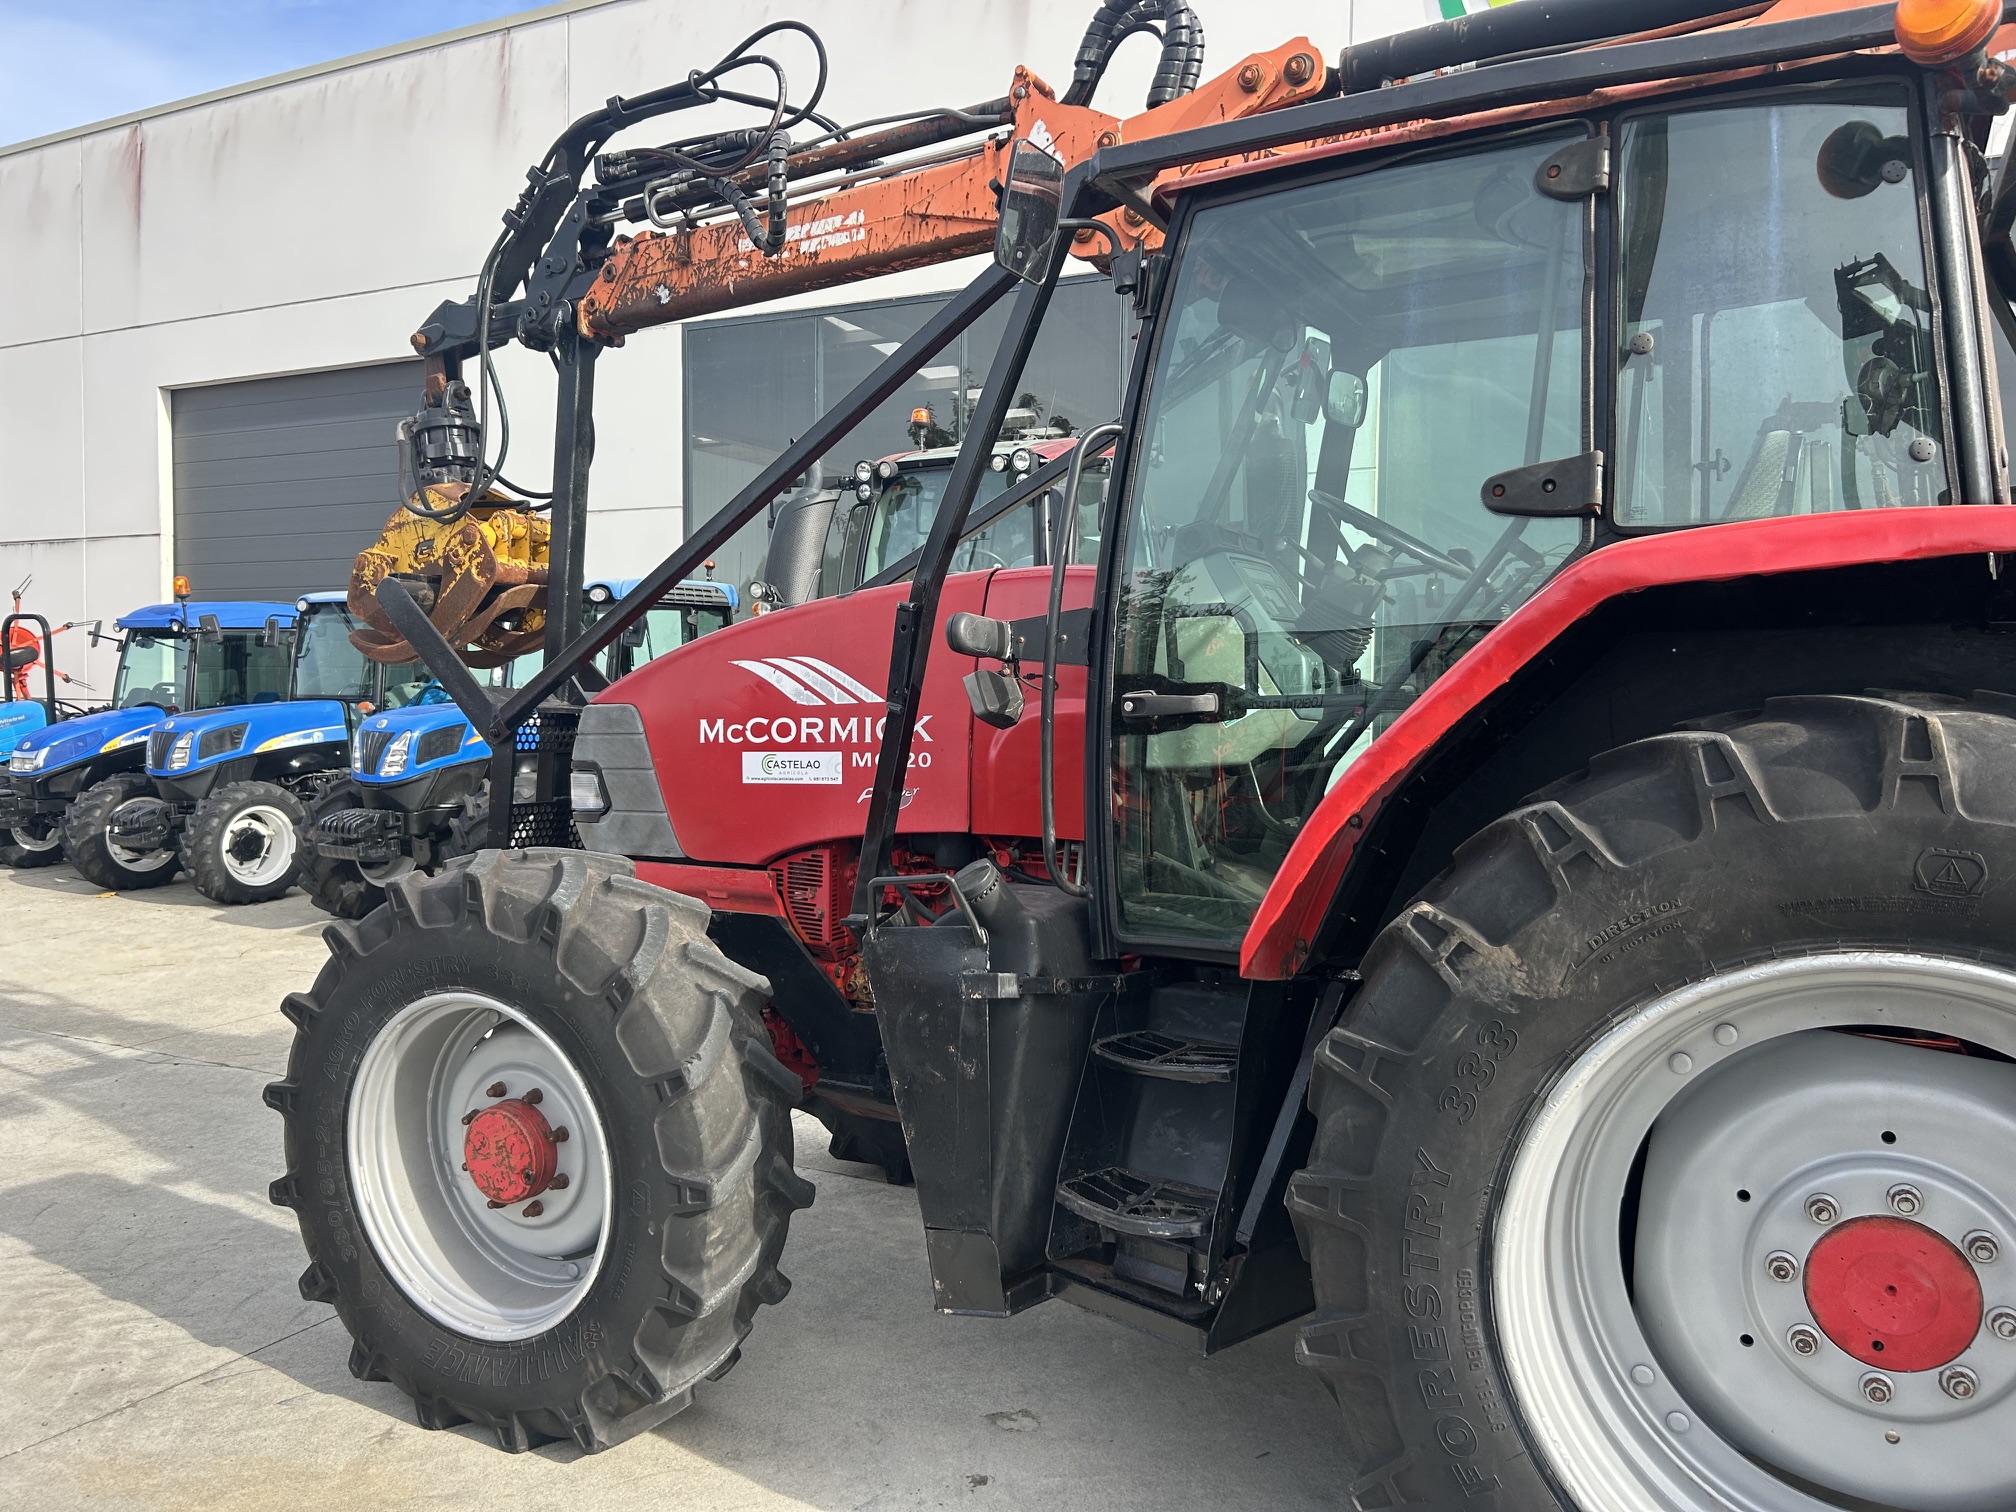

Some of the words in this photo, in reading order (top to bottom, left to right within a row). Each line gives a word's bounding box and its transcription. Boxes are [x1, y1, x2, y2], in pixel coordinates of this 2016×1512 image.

[766, 760, 821, 769] CASTELAO
[1587, 897, 1682, 951] DIRECTION
[1621, 920, 1682, 953] ROTATION
[322, 1011, 360, 1082] AGRO
[360, 955, 474, 1011] FORESTRY
[486, 963, 531, 995] 333
[1438, 1019, 1520, 1125] 333
[1402, 1146, 1502, 1499] FORESTRY
[1456, 1268, 1486, 1371] REINFORCED
[420, 1326, 586, 1387] ALLIANCE
[1474, 1378, 1507, 1434] STEEL
